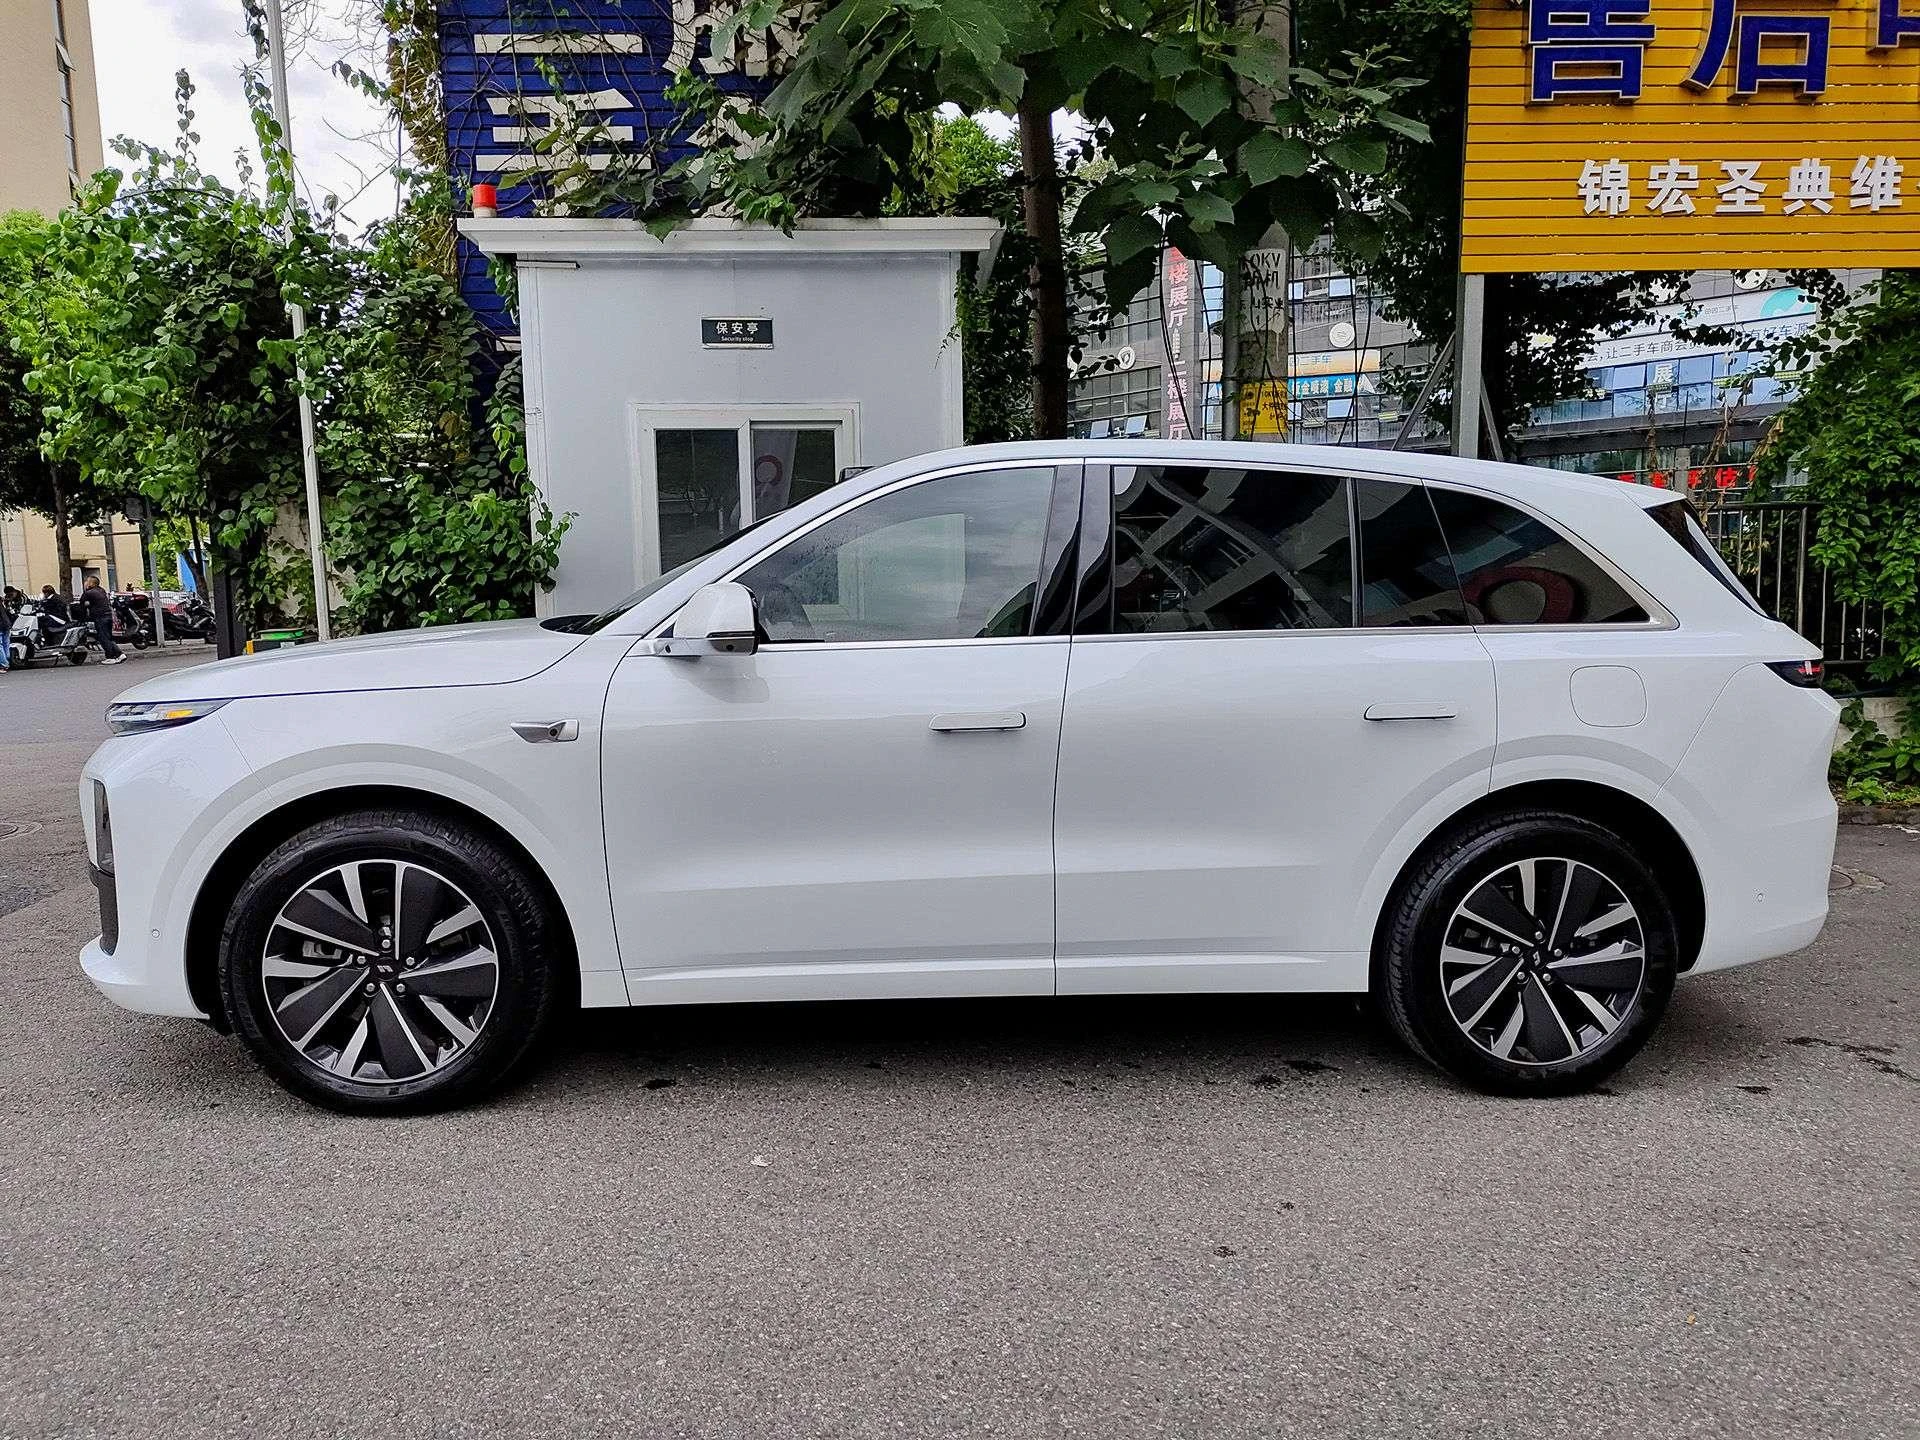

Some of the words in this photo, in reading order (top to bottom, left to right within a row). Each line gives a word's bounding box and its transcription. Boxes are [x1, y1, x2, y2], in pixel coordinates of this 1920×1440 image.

[1529, 0, 1920, 101] 售后
[1577, 155, 1920, 216] 锦宏圣典维
[716, 321, 758, 334] 保安亭
